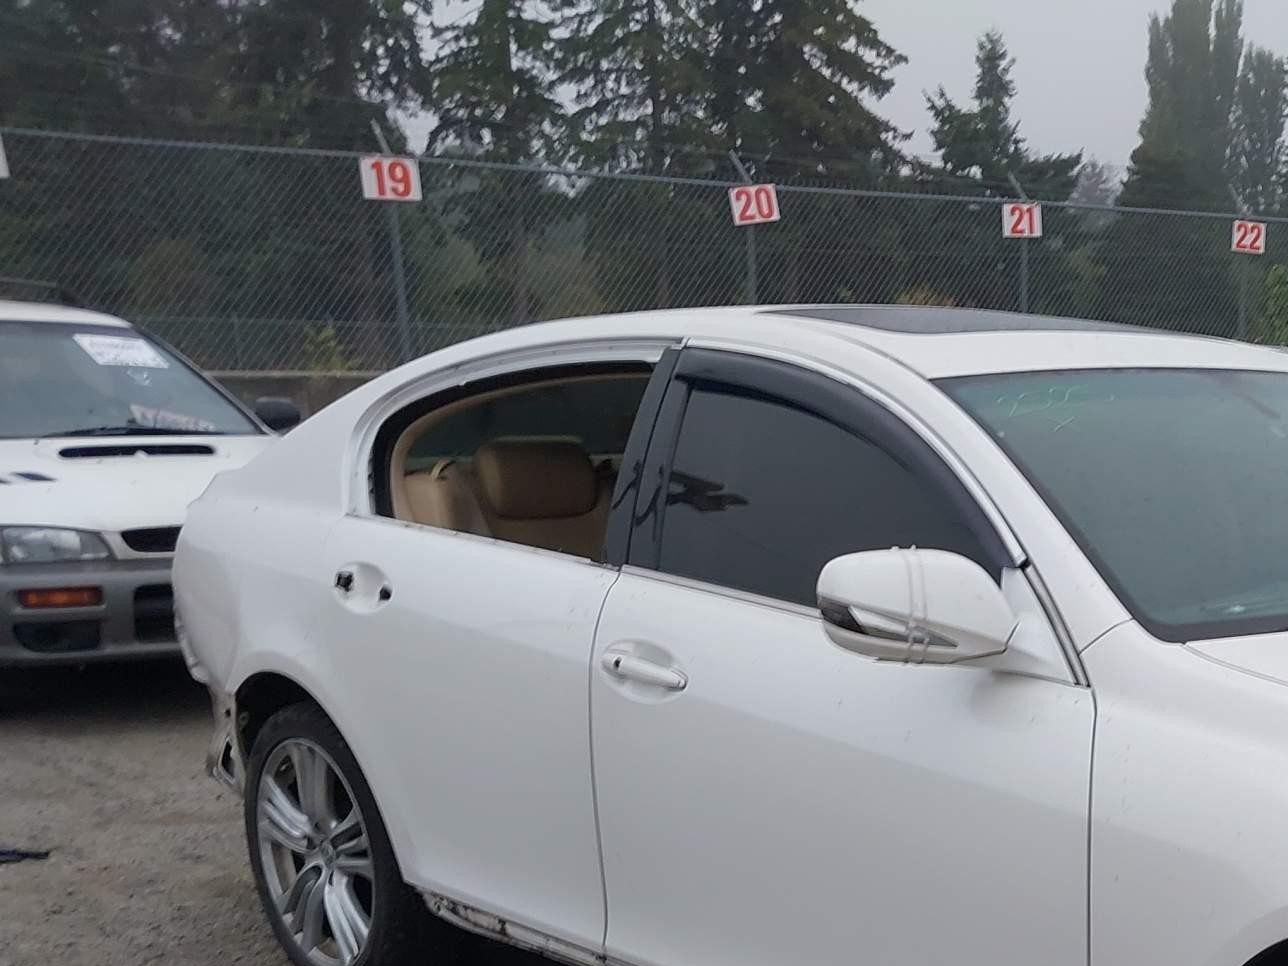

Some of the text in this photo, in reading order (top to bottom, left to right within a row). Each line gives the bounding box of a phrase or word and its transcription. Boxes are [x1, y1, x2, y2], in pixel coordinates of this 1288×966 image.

[371, 161, 411, 197] 19
[735, 189, 774, 221] 20
[1009, 206, 1034, 234] 21
[1235, 225, 1262, 250] 22
